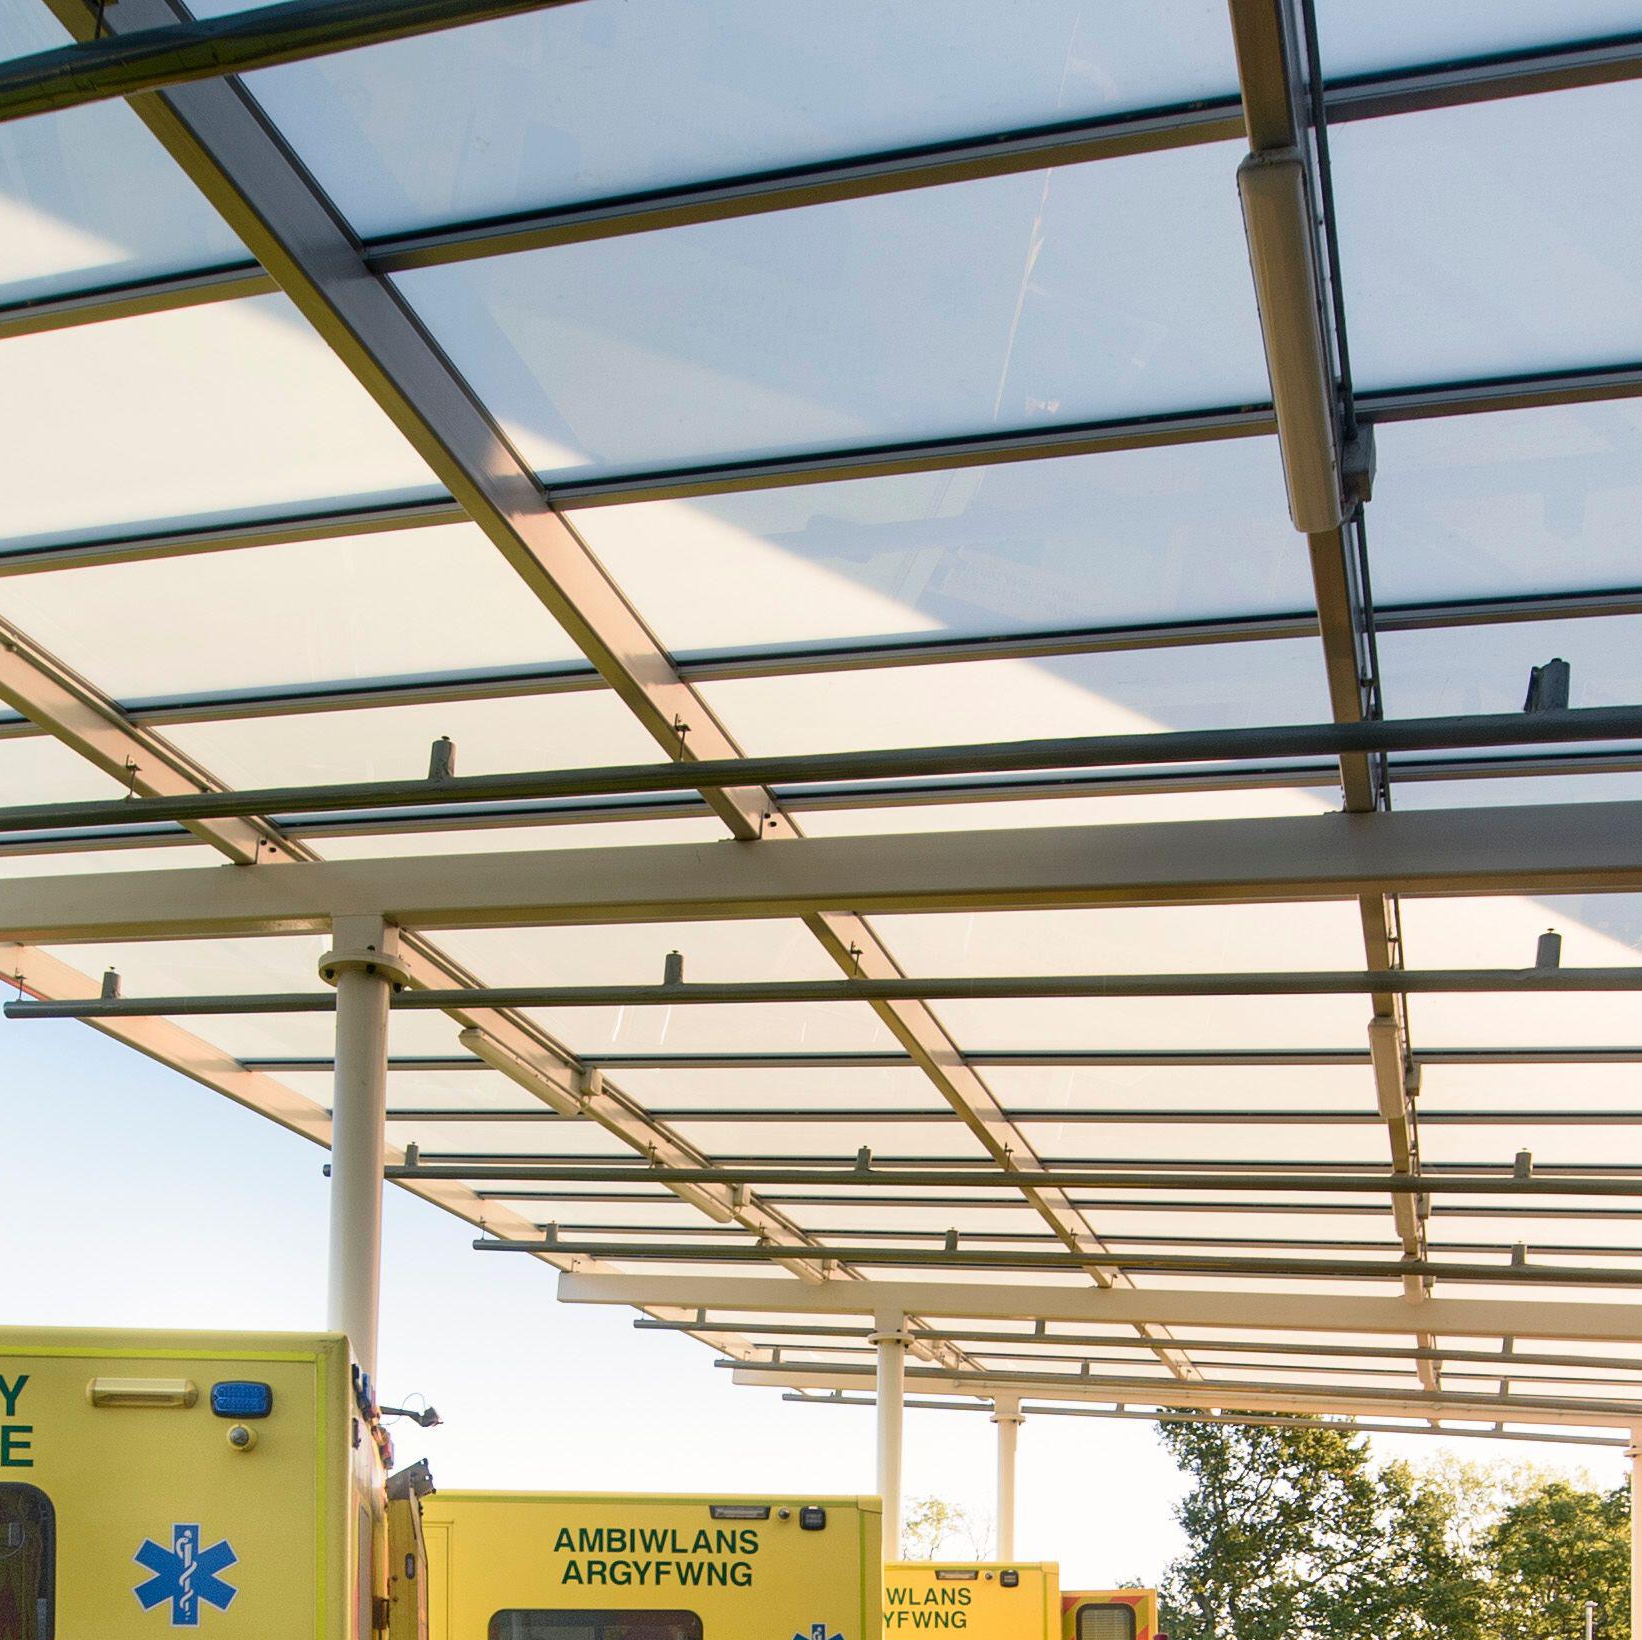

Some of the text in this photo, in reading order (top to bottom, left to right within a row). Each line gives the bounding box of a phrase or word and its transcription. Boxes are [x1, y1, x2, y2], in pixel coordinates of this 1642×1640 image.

[553, 1528, 759, 1554] AMBIWLANS
[560, 1560, 754, 1587] ARGYFWNG
[886, 1587, 972, 1606] WLANS
